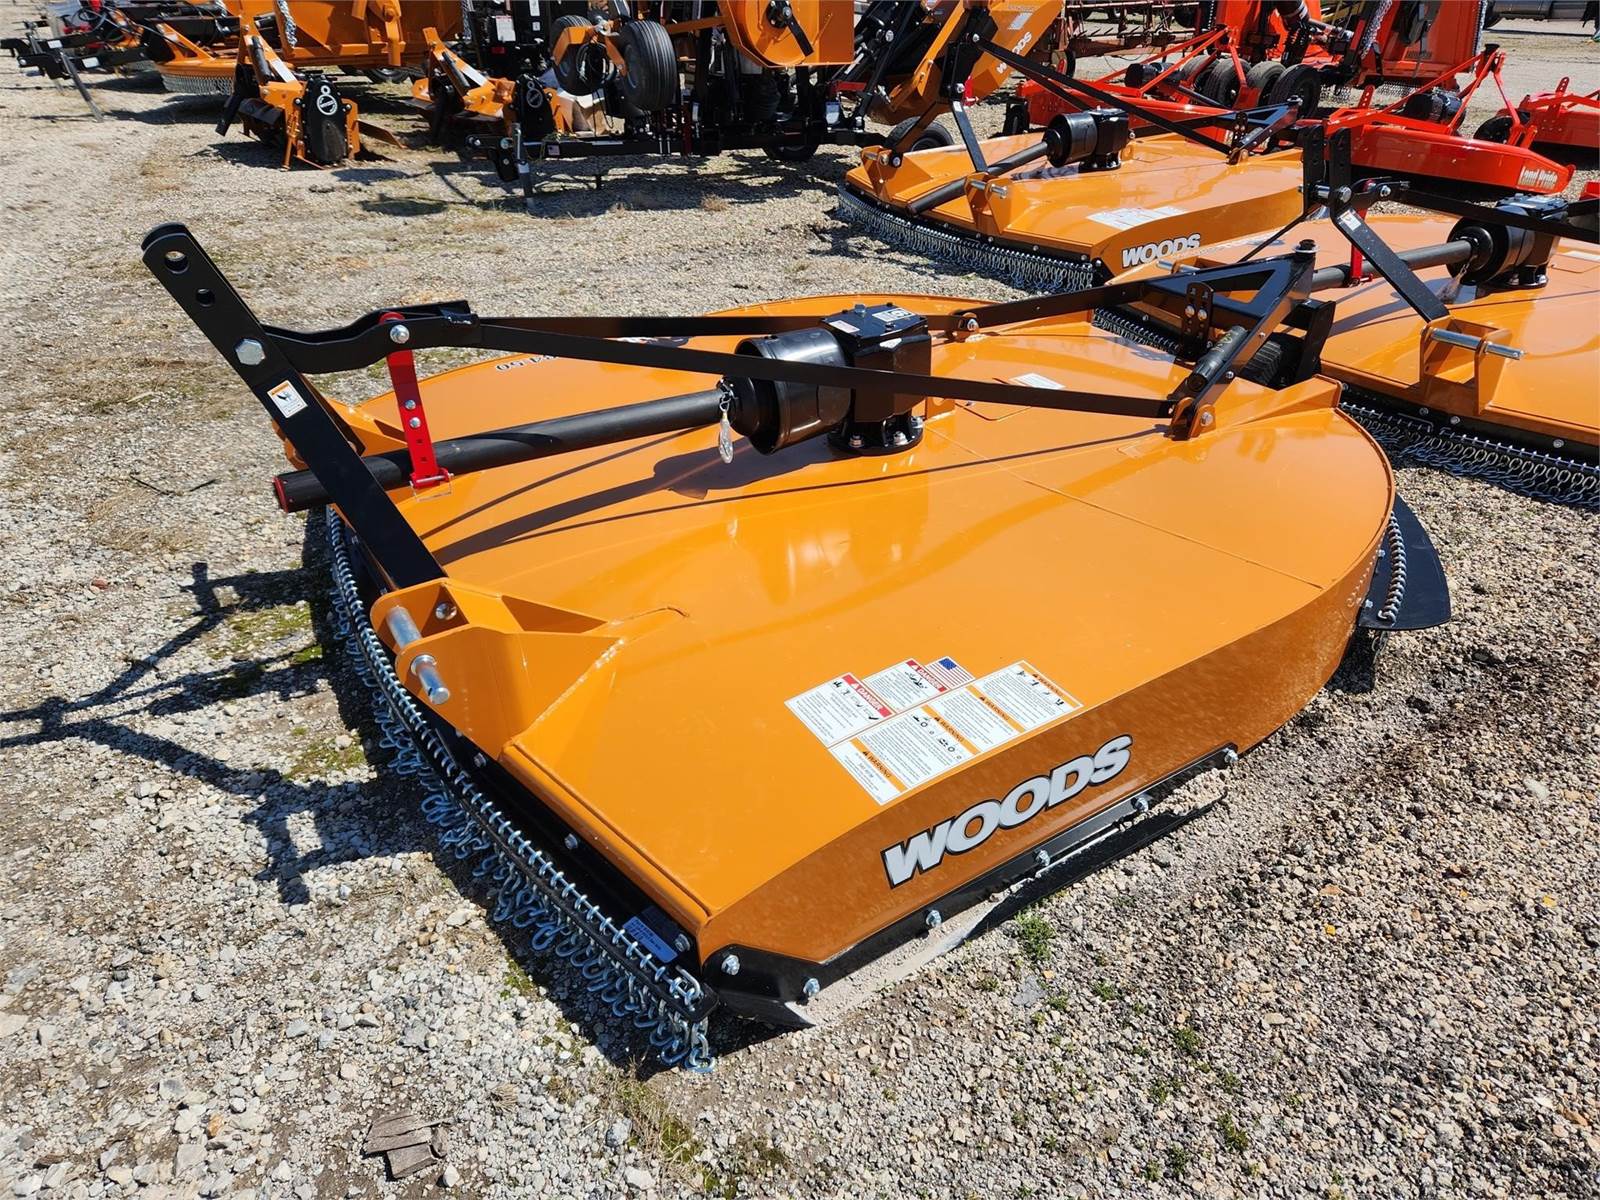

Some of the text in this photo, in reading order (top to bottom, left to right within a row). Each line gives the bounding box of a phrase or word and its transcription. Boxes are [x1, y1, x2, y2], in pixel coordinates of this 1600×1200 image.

[996, 31, 1033, 74] WODS
[1122, 233, 1201, 269] WOODS
[868, 754, 892, 778] WARNING
[880, 733, 1134, 889] WOODS
